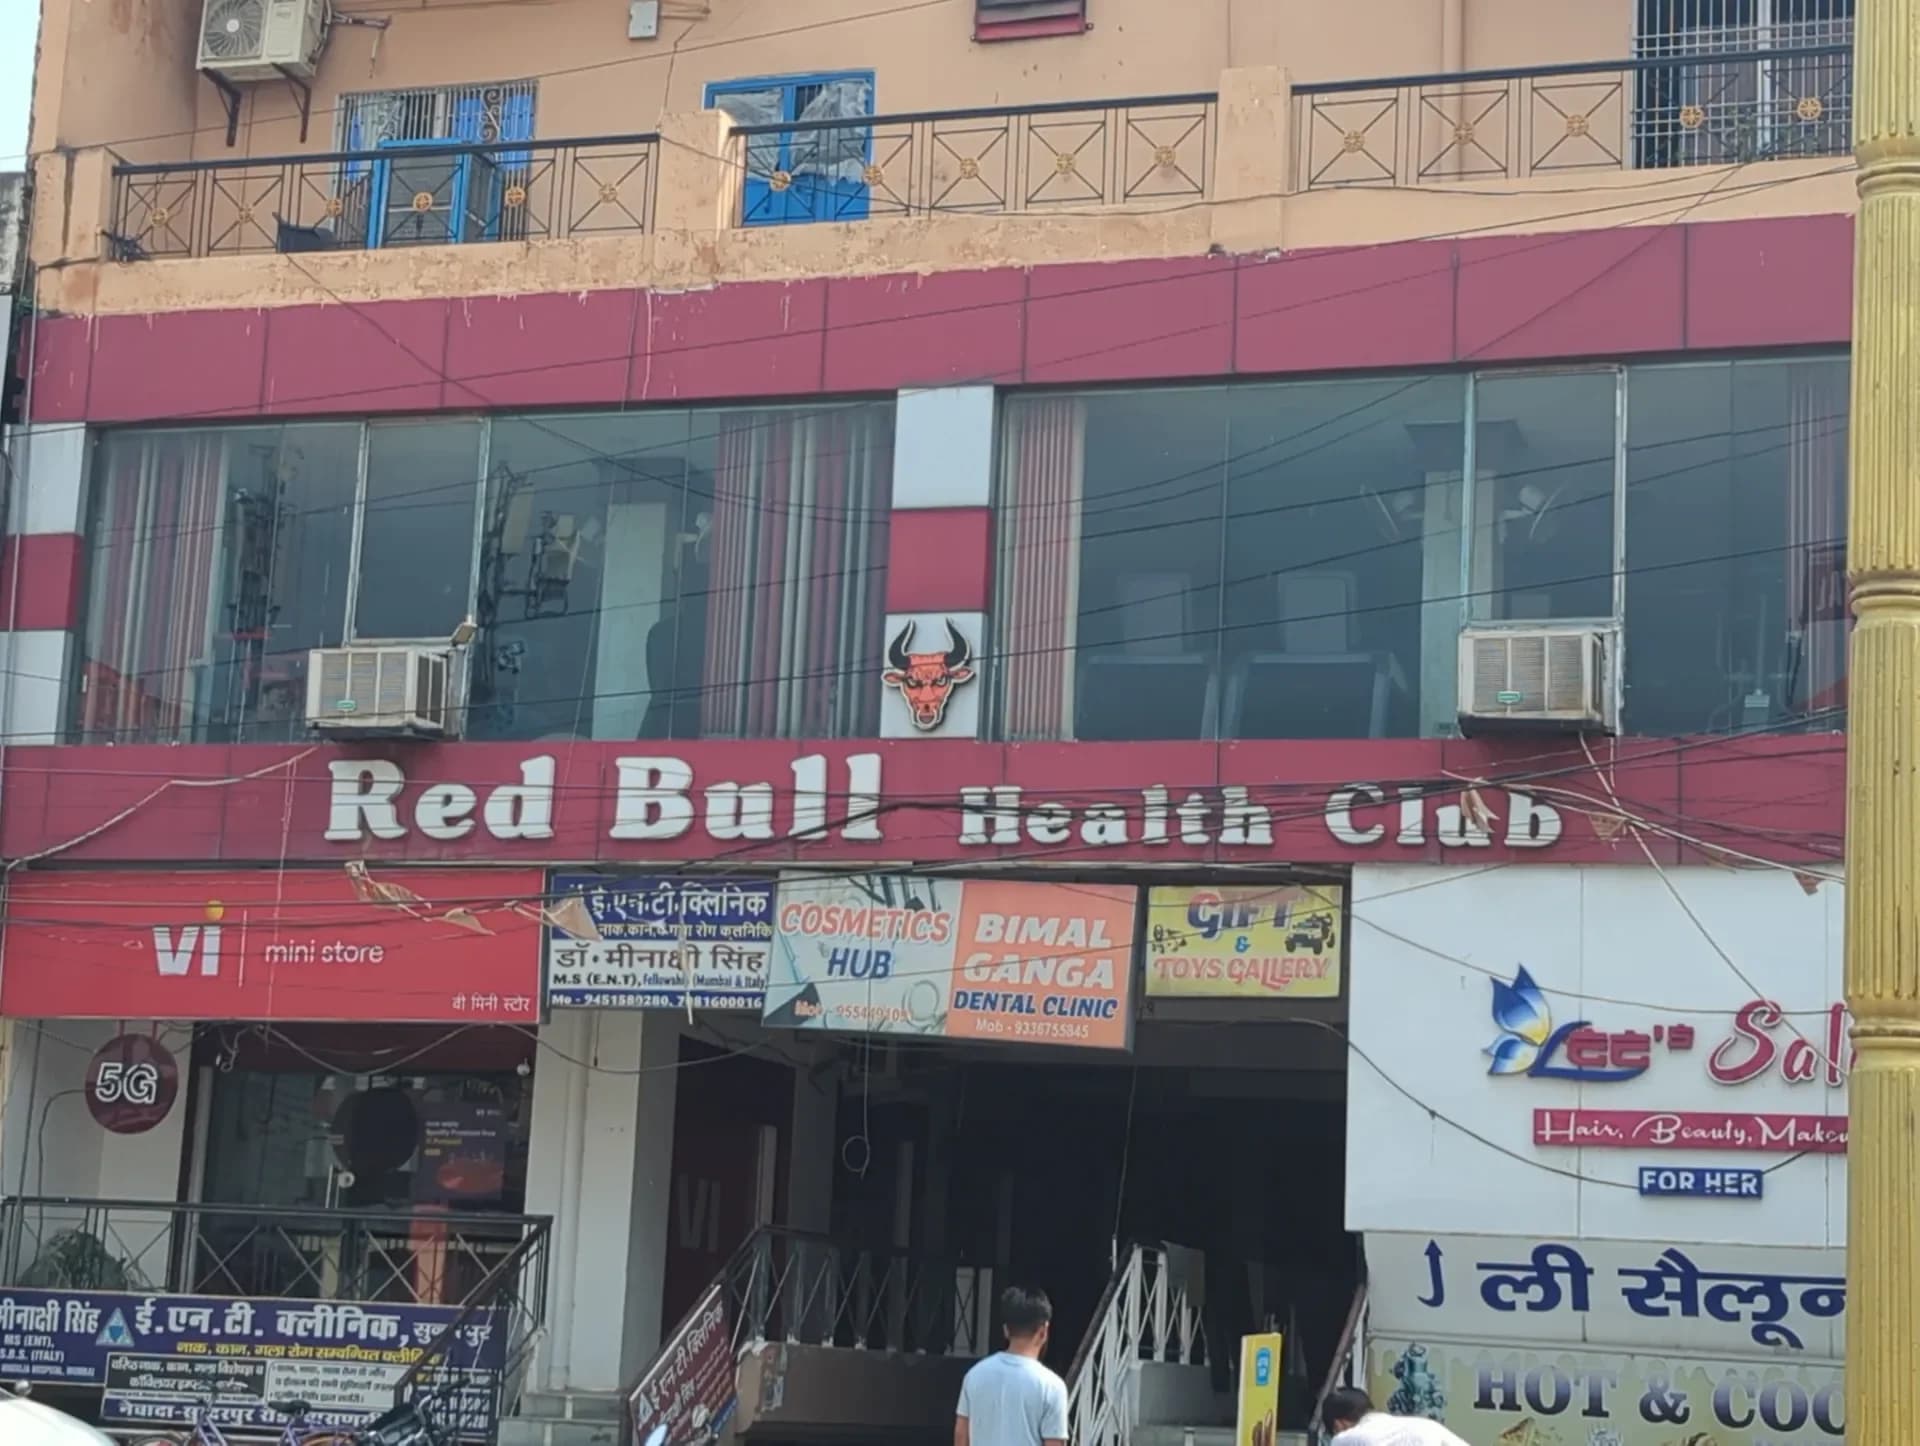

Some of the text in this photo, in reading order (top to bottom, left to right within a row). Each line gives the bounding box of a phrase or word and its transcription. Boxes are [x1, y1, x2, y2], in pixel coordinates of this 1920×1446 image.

[324, 752, 1563, 848] Red Bull Health Club
[780, 903, 951, 943] COSMETICS
[975, 912, 1113, 949] BIMAL
[265, 939, 385, 964] mini store
[712, 944, 766, 972] सिंह
[1235, 936, 1251, 953] &
[827, 946, 893, 979] HUB
[963, 953, 1115, 989] GANGA
[1154, 957, 1330, 990] TOYS GALLERY
[452, 992, 530, 1012] वी मिनी स्टोर
[953, 991, 1118, 1018] DENTAL CLINIC
[976, 1019, 1004, 1033] Mob
[96, 1062, 159, 1104] 5G
[1642, 1170, 1758, 1195] FOR HER
[1476, 1243, 1594, 1313] ली
[65, 1300, 102, 1334] सिंह
[287, 1342, 314, 1359] रोग
[1473, 1361, 1617, 1418] HOT
[1638, 1370, 1691, 1424] &
